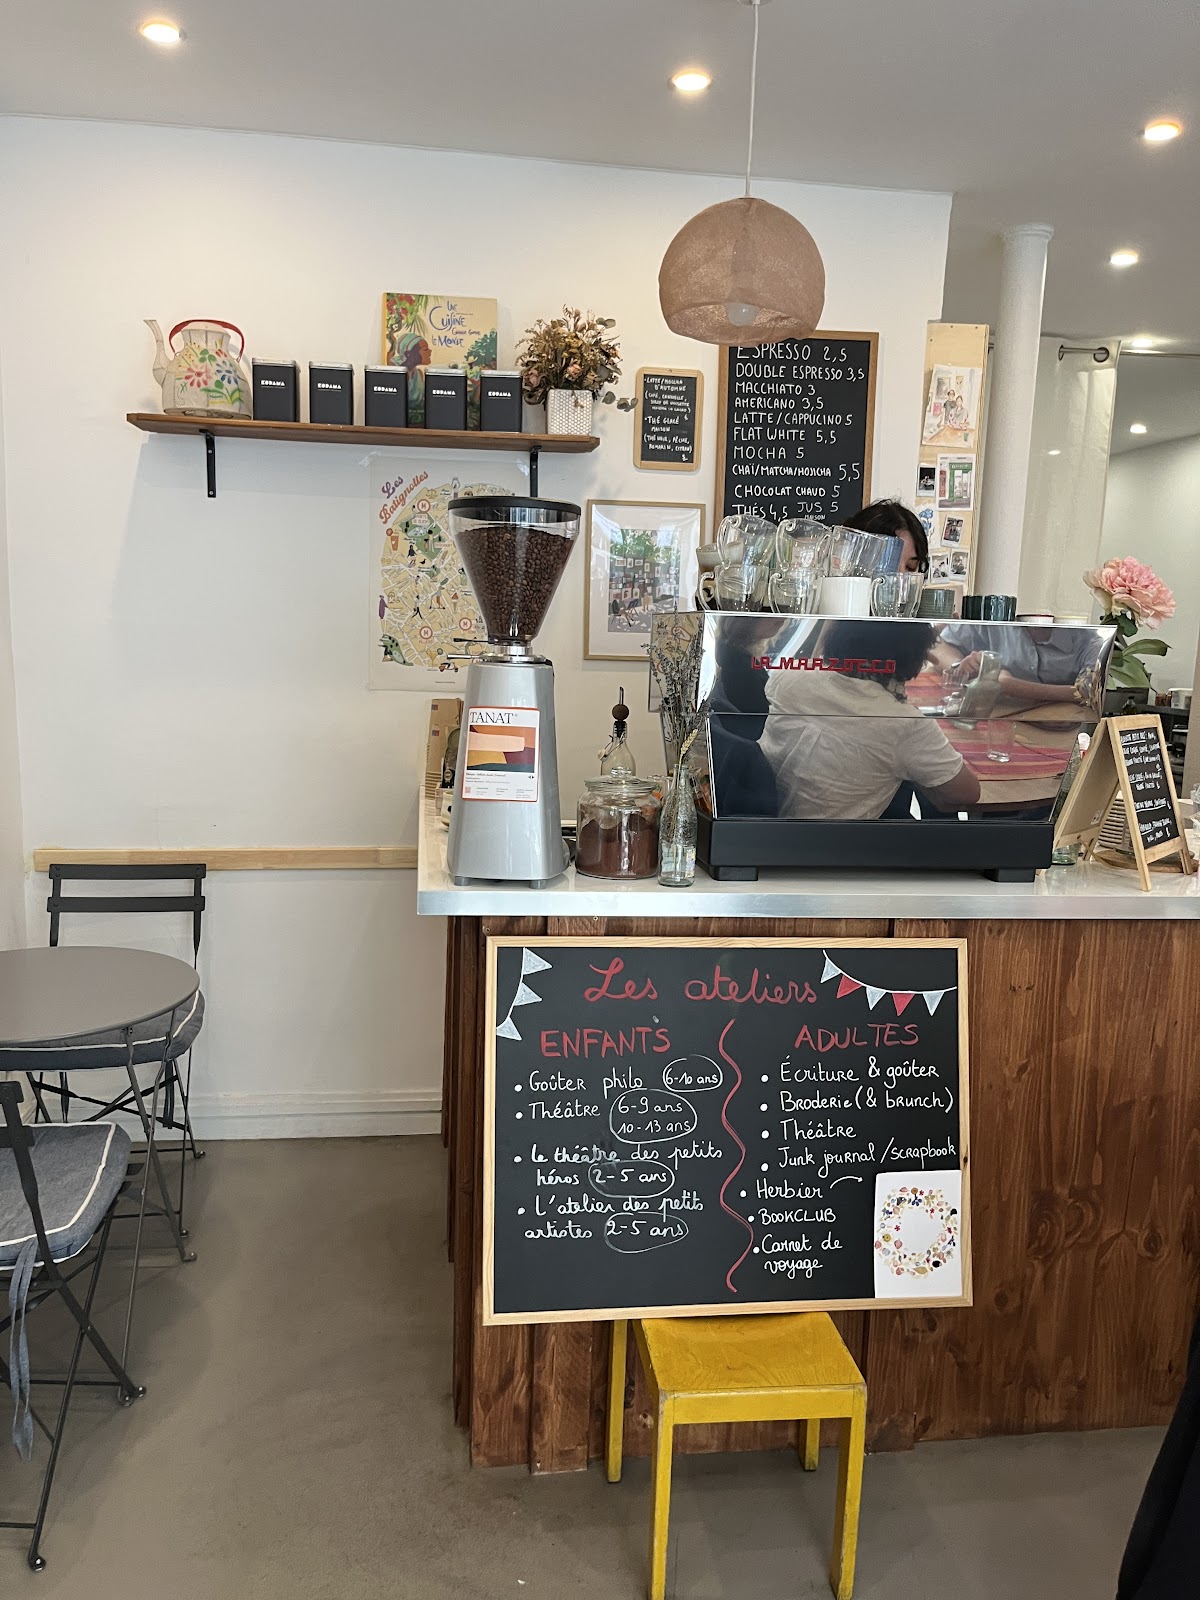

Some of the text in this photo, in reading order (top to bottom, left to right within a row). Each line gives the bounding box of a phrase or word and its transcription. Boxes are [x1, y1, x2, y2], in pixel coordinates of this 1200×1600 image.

[737, 342, 847, 362] ESPRESSO 2,5
[736, 363, 865, 383] DOUBLE ESPRESSO 3,5
[735, 381, 816, 396] MACCHIATO 3
[734, 396, 824, 411] AMERICANO 3,5
[844, 414, 853, 426] 5
[733, 427, 837, 444] FLAT WHITE 5,5
[733, 446, 805, 460] MOCHA 5
[838, 463, 861, 482] 5,5
[379, 470, 429, 524] Batignolles
[381, 475, 404, 499] Les
[734, 484, 841, 499] CHOCOLAT CHAUD 5
[732, 503, 788, 523] THÉS 4,5
[797, 501, 839, 513] JUS 5
[752, 656, 897, 673] LA MARZOCCO
[470, 712, 513, 724] TANAT
[583, 957, 817, 1005] Les ateliers
[541, 1026, 671, 1059] ENFANTS
[794, 1023, 920, 1052] ADULTES
[780, 1055, 940, 1088] Écriture & goûter
[529, 1069, 587, 1092] Goûter
[603, 1066, 644, 1099] philo
[696, 1073, 719, 1085] ans
[528, 1096, 683, 1119] Théâtre 6-9 ans
[885, 1086, 954, 1114] brunch)
[666, 1120, 692, 1132] ans
[780, 1118, 857, 1140] Théâtre
[554, 1144, 621, 1164] théâtre
[630, 1143, 660, 1161] des
[668, 1140, 723, 1170] petits
[778, 1146, 816, 1168] Junk
[817, 1142, 876, 1178] journal
[536, 1168, 580, 1186] héros
[638, 1171, 668, 1183] ans
[756, 1177, 823, 1199] Herbier
[622, 1195, 650, 1212] des
[658, 1189, 704, 1222] petits
[524, 1220, 593, 1239] artistes
[649, 1222, 684, 1238] ans
[761, 1231, 843, 1252] Carnet de
[764, 1257, 824, 1279] voyage
